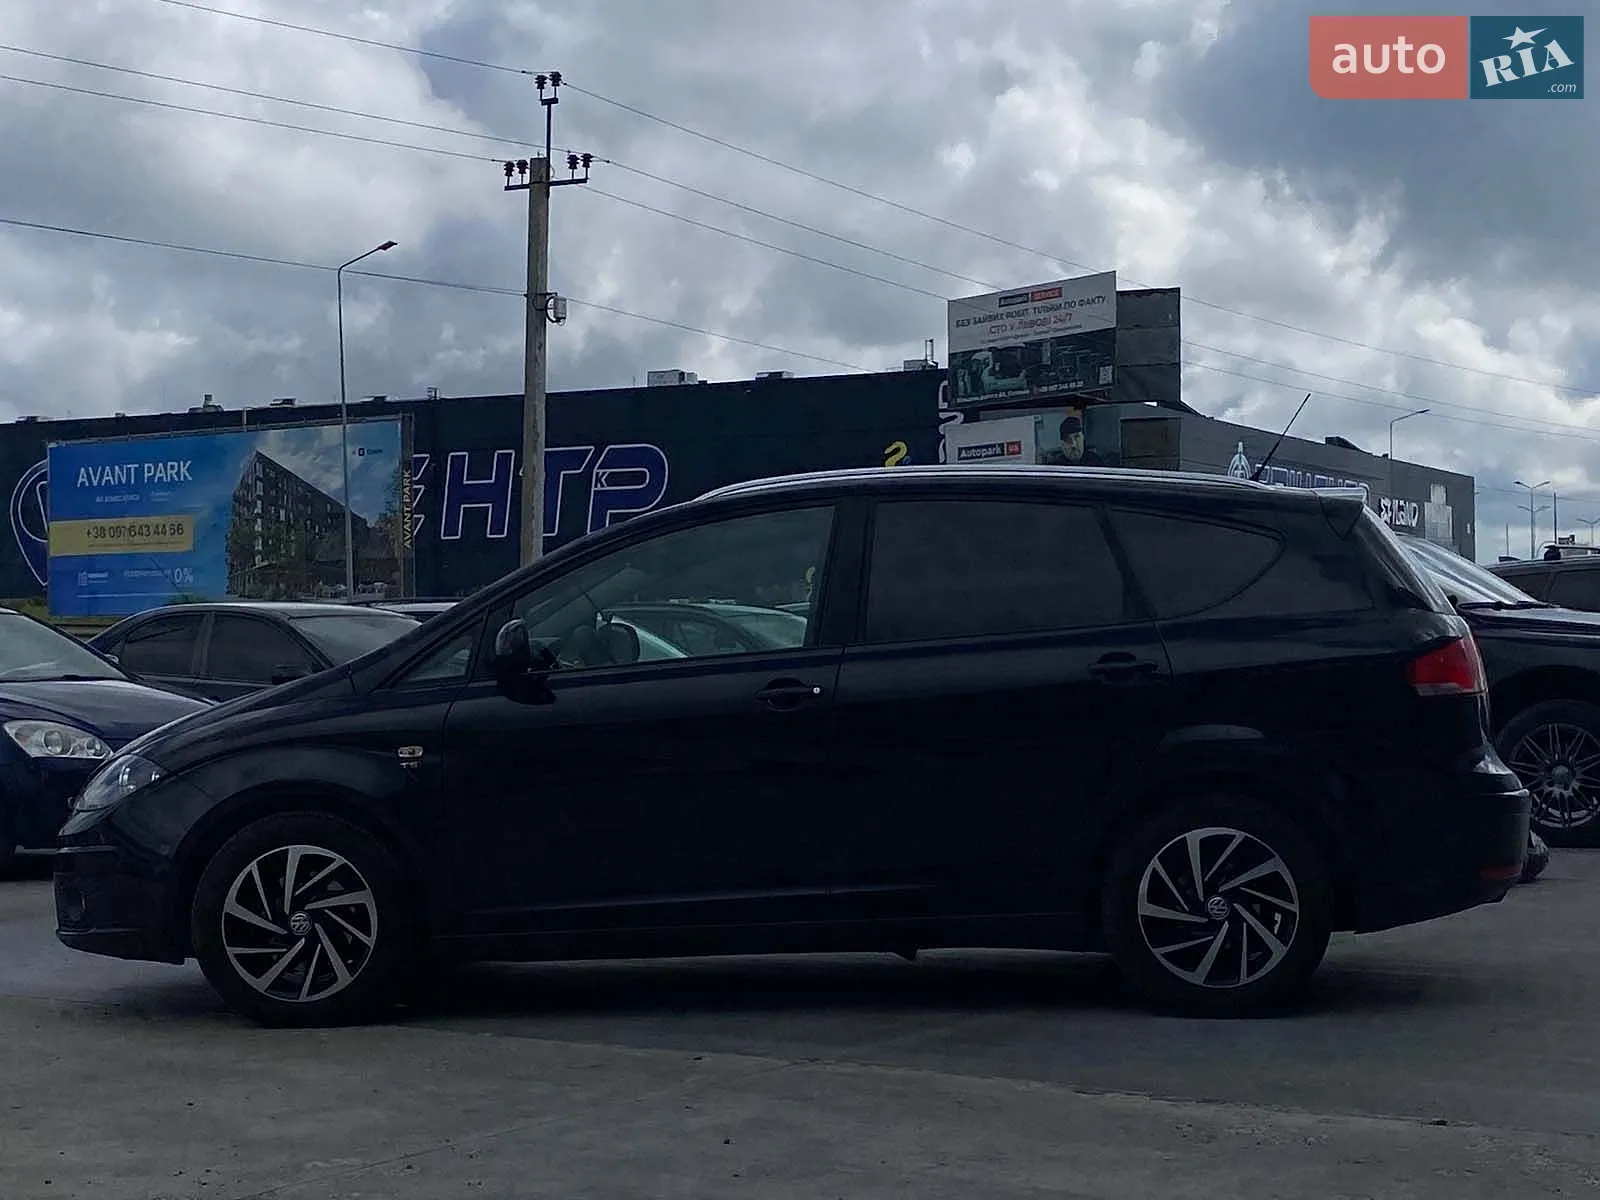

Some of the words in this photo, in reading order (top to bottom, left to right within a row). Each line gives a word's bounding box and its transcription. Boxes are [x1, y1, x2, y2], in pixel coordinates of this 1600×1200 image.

[959, 443, 1002, 458] Autopark
[76, 464, 140, 488] AVANT
[143, 460, 193, 484] PARK
[403, 469, 412, 503] PARK
[403, 506, 412, 549] AVANT
